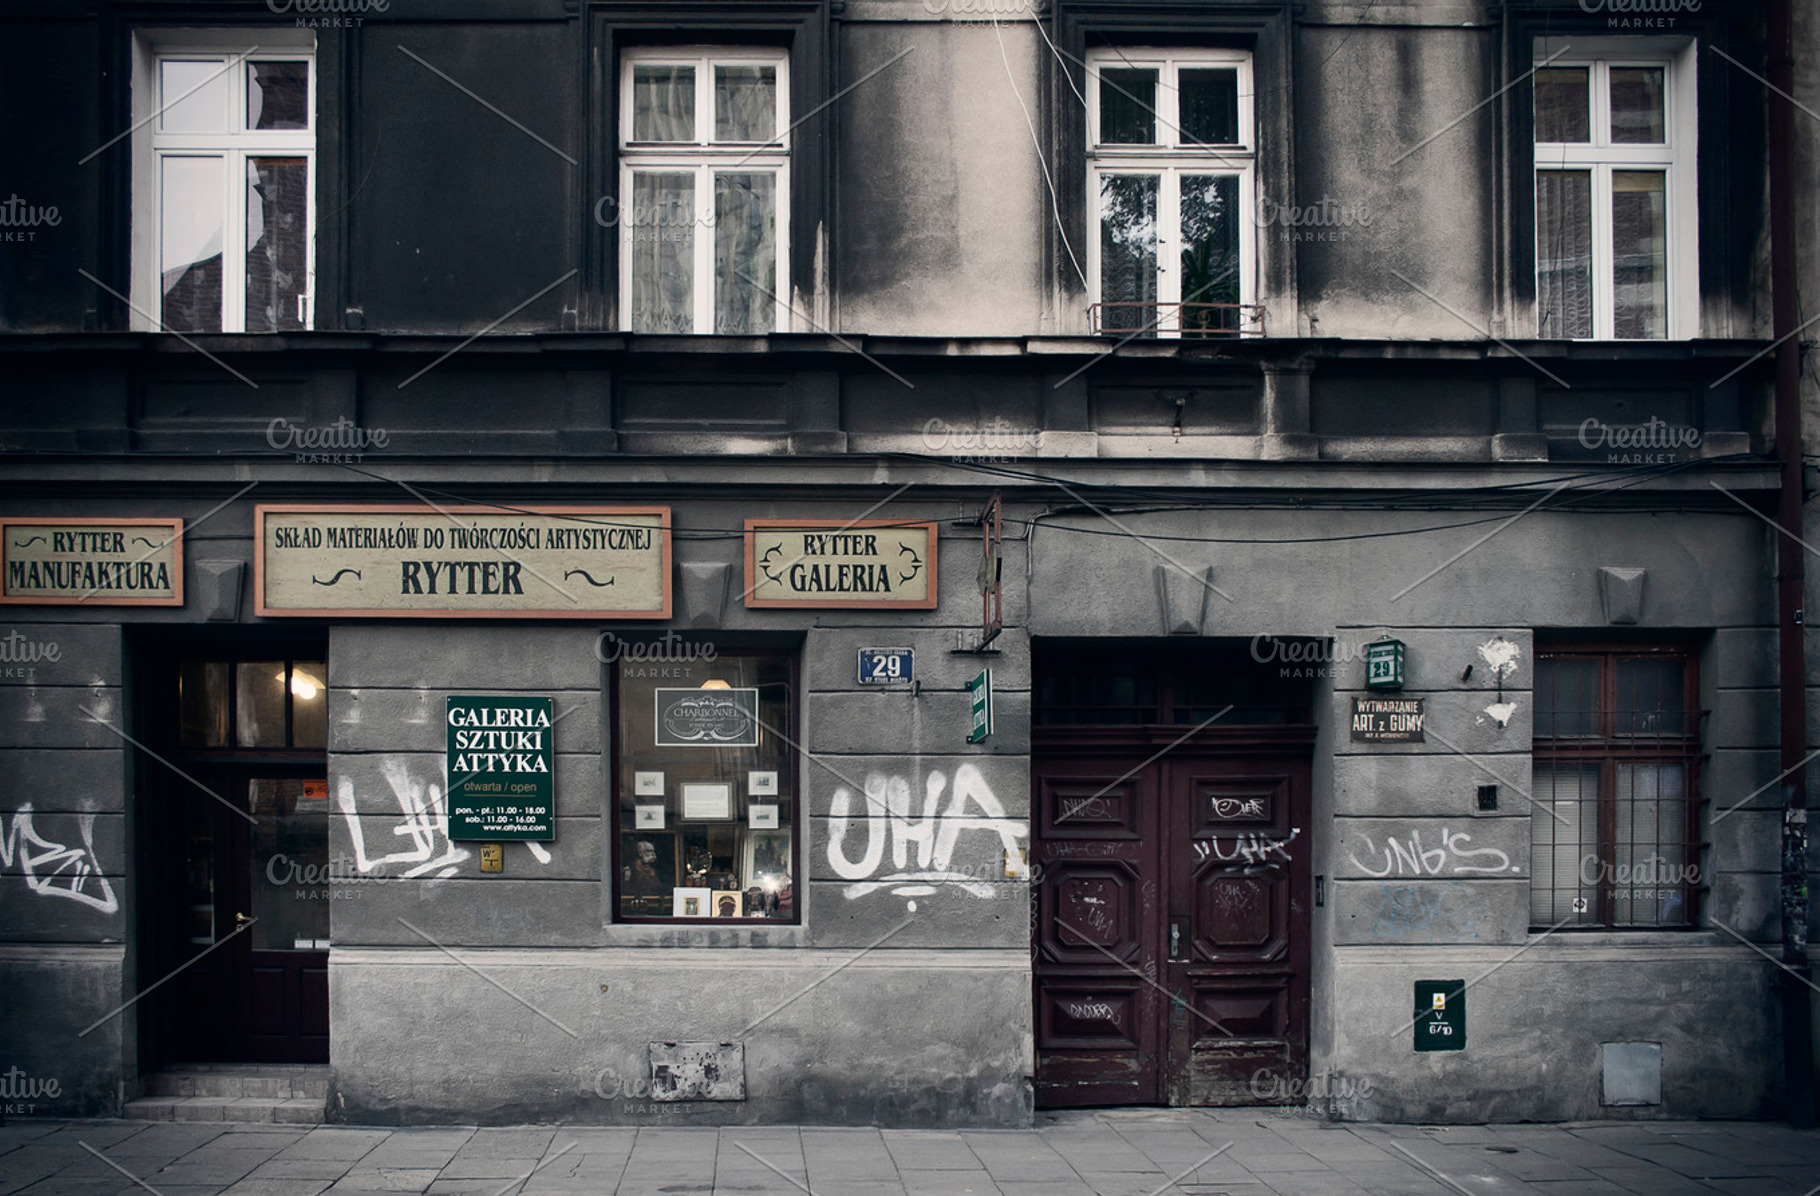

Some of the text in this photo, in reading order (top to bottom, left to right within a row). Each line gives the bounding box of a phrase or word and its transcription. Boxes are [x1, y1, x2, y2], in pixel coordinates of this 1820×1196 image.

[53, 531, 126, 553] RYTTER
[275, 521, 651, 550] SKŁAD MATERIAŁÓW DO TWÓRCZOŚCI ARTYSTYCZNEJ
[803, 534, 878, 556] RYTTER
[9, 561, 170, 590] MANUFAKTURA
[401, 561, 524, 595] RYTTER
[790, 563, 891, 592] GALERIA
[872, 655, 900, 677] 29
[1374, 661, 1390, 677] 29
[1357, 701, 1419, 713] WYTWARZANIE
[448, 707, 551, 728] GALERIA
[1352, 714, 1376, 731] ART.
[1391, 714, 1424, 731] GUMY
[455, 730, 543, 750] SZTUKI
[452, 753, 549, 773] ATTYKA
[463, 782, 502, 792] otwarta
[510, 783, 537, 793] open
[455, 807, 474, 815] pon.
[496, 806, 518, 814] 11.00
[525, 806, 546, 814] 18.00
[487, 815, 508, 823] 11.00
[515, 815, 536, 823] 16.00
[482, 824, 547, 833] www.attyka.com
